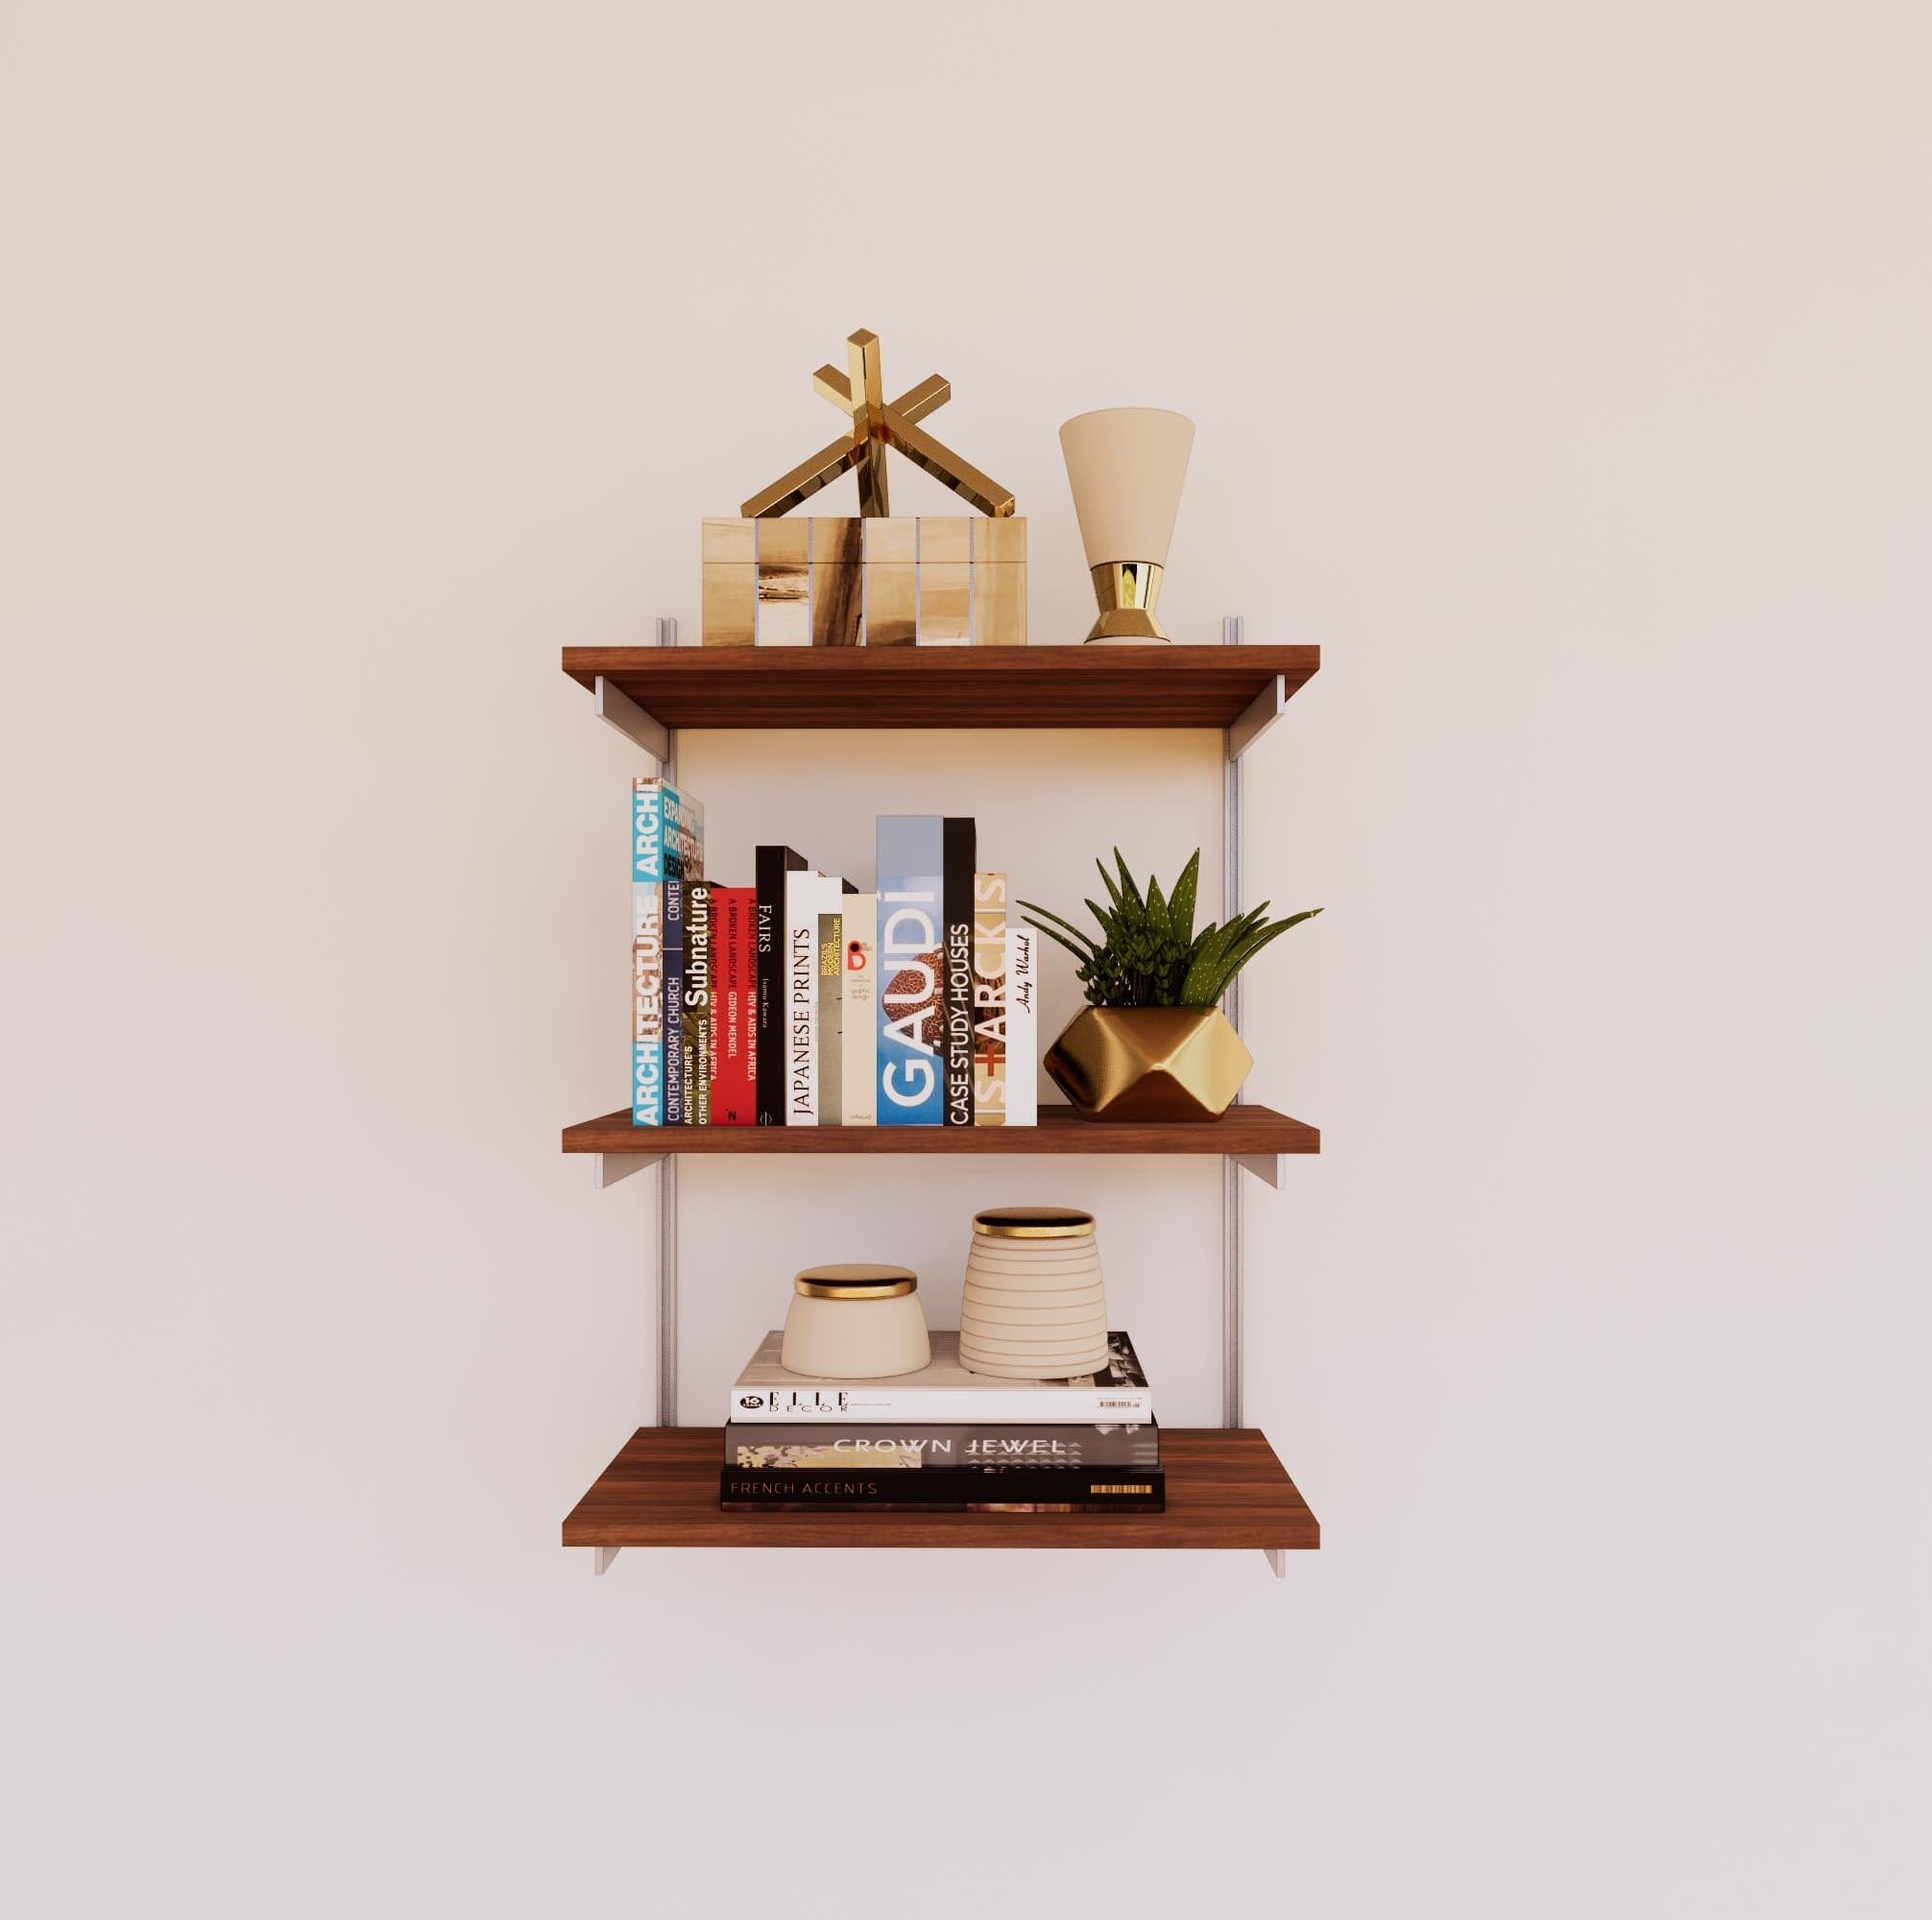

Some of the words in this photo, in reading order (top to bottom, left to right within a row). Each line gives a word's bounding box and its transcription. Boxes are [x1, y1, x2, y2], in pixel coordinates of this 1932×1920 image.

[667, 880, 680, 921] CONTE
[729, 907, 737, 940] BROKEN
[747, 907, 757, 940] BROKEN
[759, 904, 772, 952] FAIRS
[685, 887, 709, 1006] Subnature
[729, 942, 737, 990] LANDSCAPE
[747, 942, 757, 990] LANDSCAPE
[793, 929, 809, 1003] PRINTS
[951, 924, 969, 1001] HOUSES
[1015, 934, 1030, 975] Warhol
[636, 895, 659, 1125] ARCHITECTURE
[667, 977, 680, 1023] CHURCH
[729, 992, 737, 1022] GIDEON
[747, 992, 757, 1006] HIV
[1016, 981, 1032, 1014] Andy
[729, 1024, 737, 1058] MENDEL
[747, 1018, 757, 1037] AIDS
[747, 1040, 757, 1049] IN
[951, 1007, 969, 1068] STUDY
[667, 1027, 680, 1121] CONTEMPORARY
[698, 1019, 708, 1091] ENVIRONMENTS
[747, 1052, 757, 1081] AFRICA
[793, 1011, 813, 1115] JAPANESE
[684, 1045, 692, 1124] ARCHITECTURE'S
[951, 1074, 969, 1125] CASE
[698, 1093, 708, 1124] OTHER
[770, 1392, 848, 1405] ELLE
[833, 1439, 952, 1452] CROWN
[964, 1439, 1066, 1453] JEWEL
[731, 1482, 794, 1495] FRENCH
[802, 1482, 878, 1495] ACCENTS
